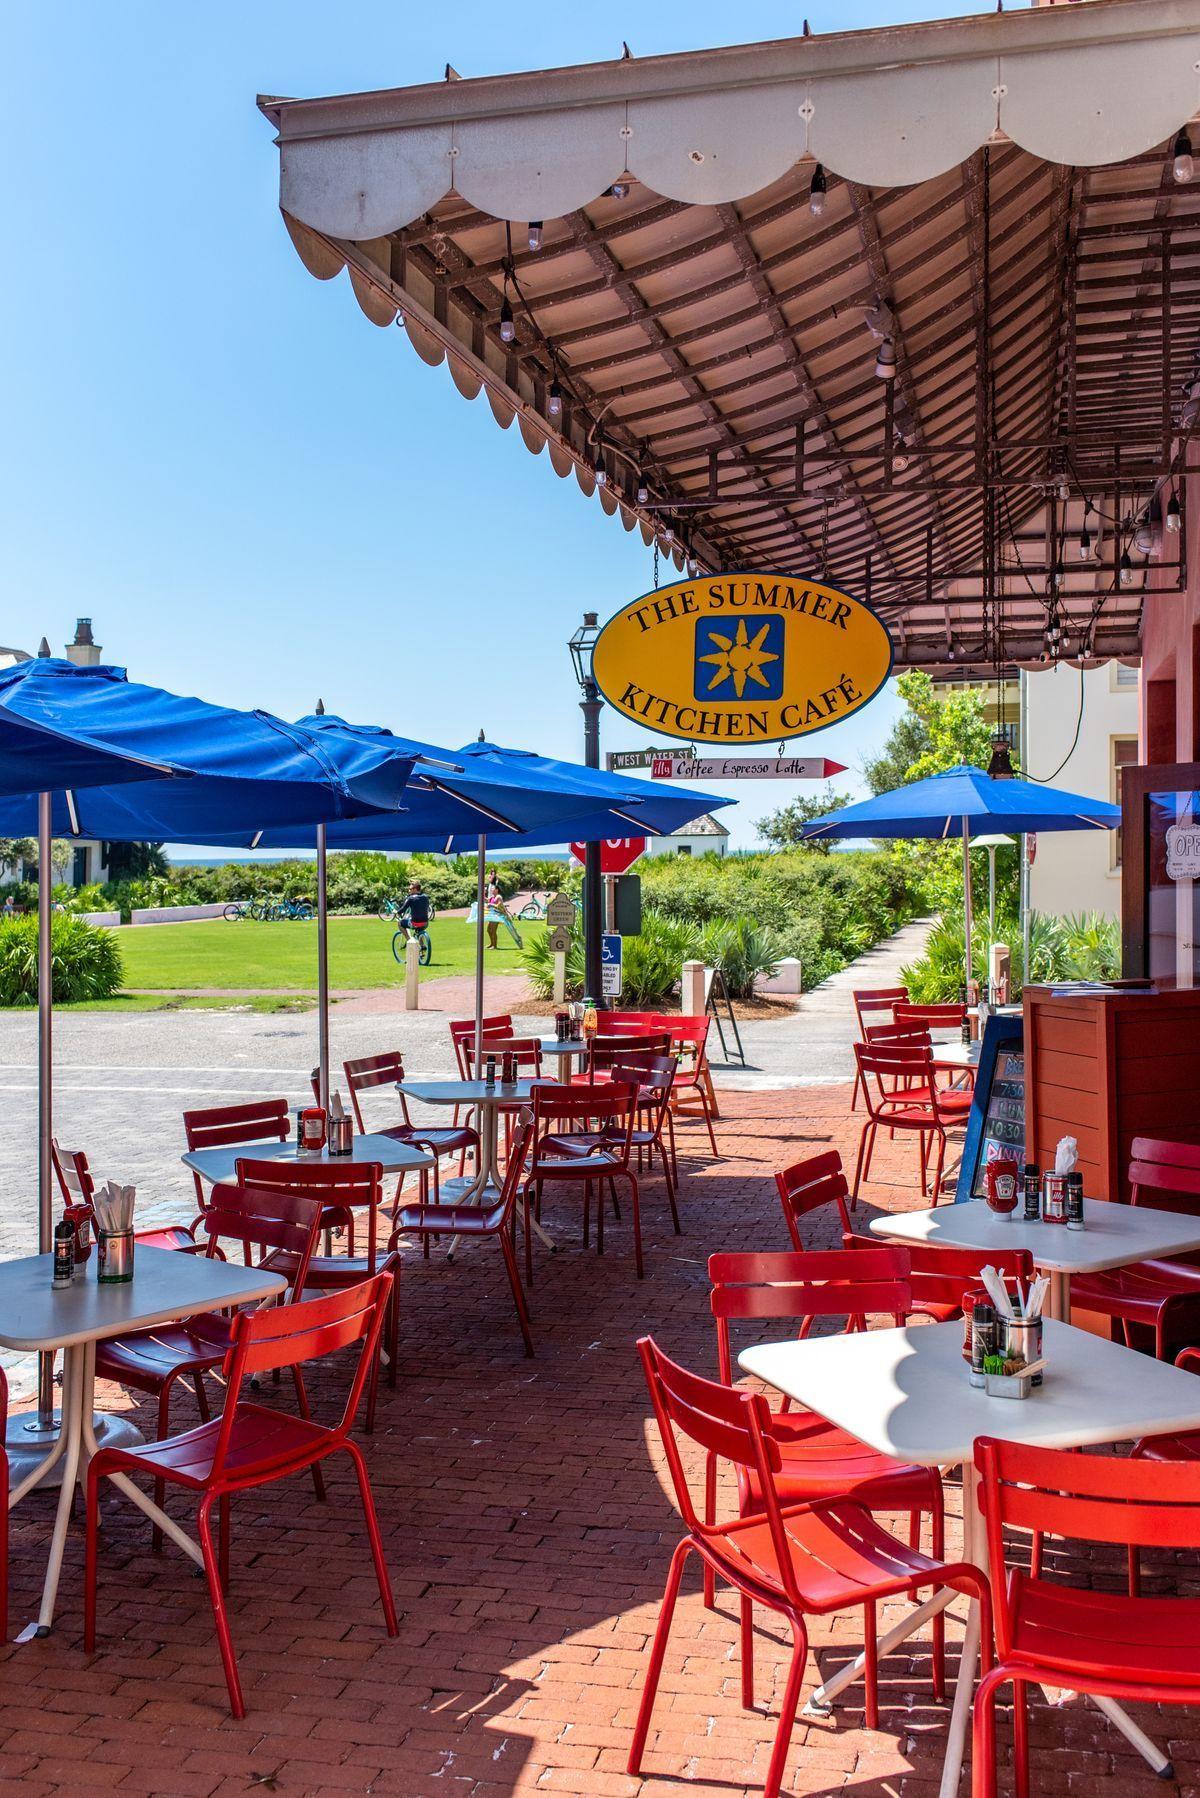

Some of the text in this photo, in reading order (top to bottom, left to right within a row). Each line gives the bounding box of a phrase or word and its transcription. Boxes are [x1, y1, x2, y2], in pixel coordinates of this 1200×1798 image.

[627, 583, 852, 633] THE SUMMER
[618, 673, 863, 736] KITCHEN CAFÉ
[617, 754, 640, 766] WEST
[678, 751, 689, 759] ST
[654, 759, 805, 778] illy Coffee Espresso Latte
[1176, 834, 1200, 856] OPE
[555, 940, 565, 949] G
[1005, 1057, 1024, 1076] BRE
[1000, 1102, 1025, 1120] LUN
[989, 1119, 1020, 1138] 10:30
[1052, 1191, 1064, 1201] illy
